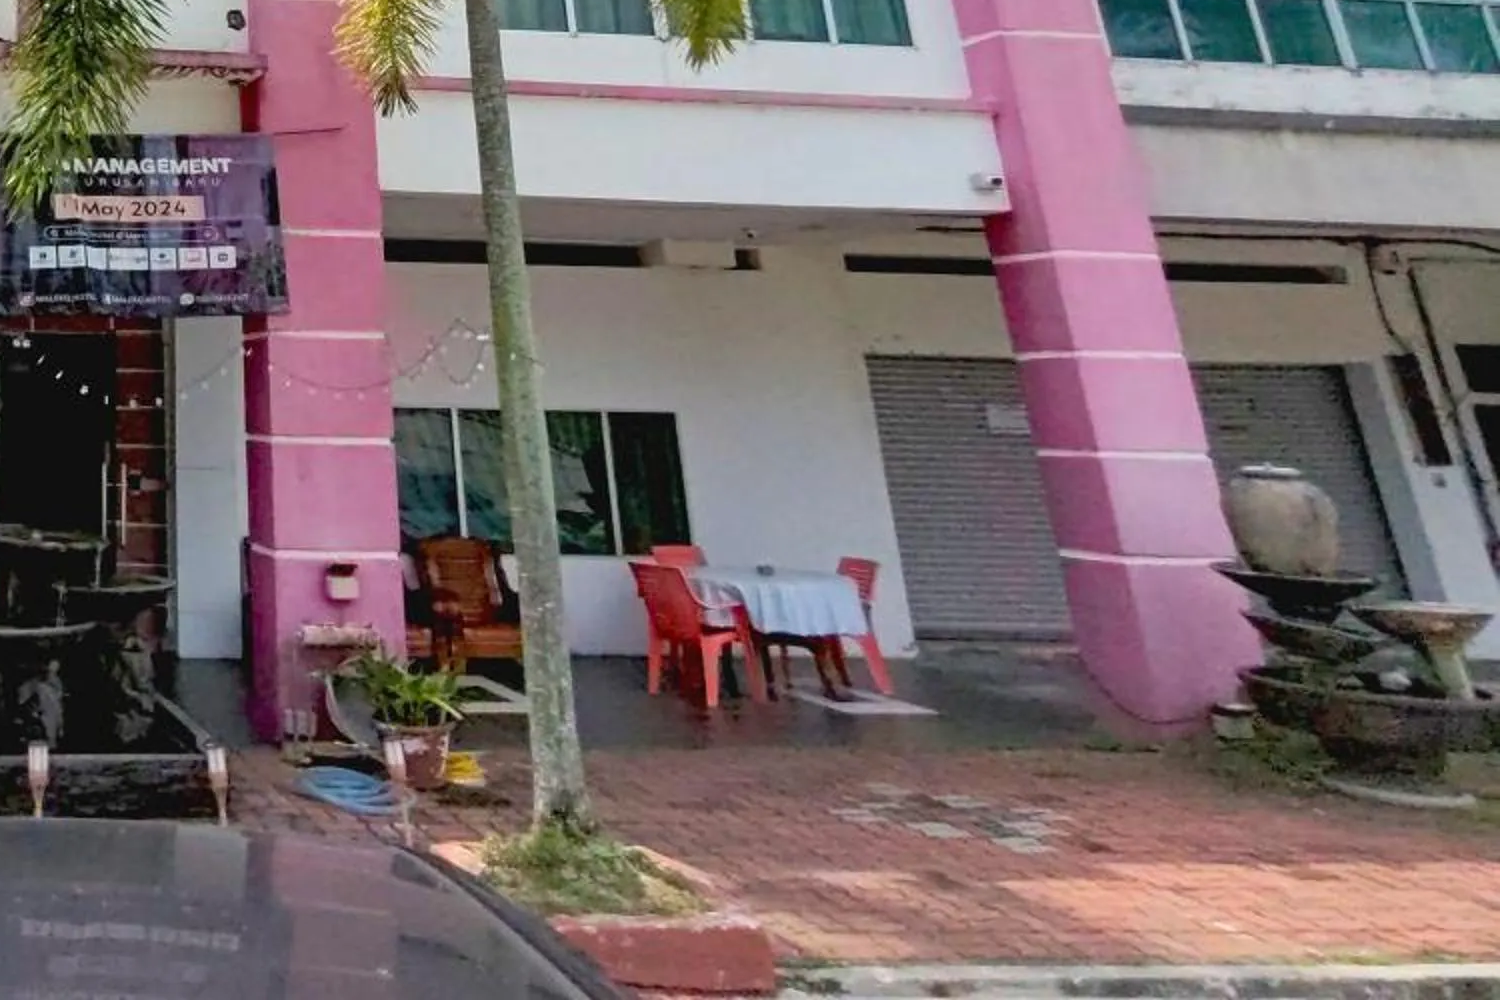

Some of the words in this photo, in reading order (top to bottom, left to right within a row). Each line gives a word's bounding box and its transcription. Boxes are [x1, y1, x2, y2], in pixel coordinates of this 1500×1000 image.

[72, 157, 232, 174] MANAGEMENT
[80, 201, 124, 219] May
[130, 200, 186, 217] 2024
